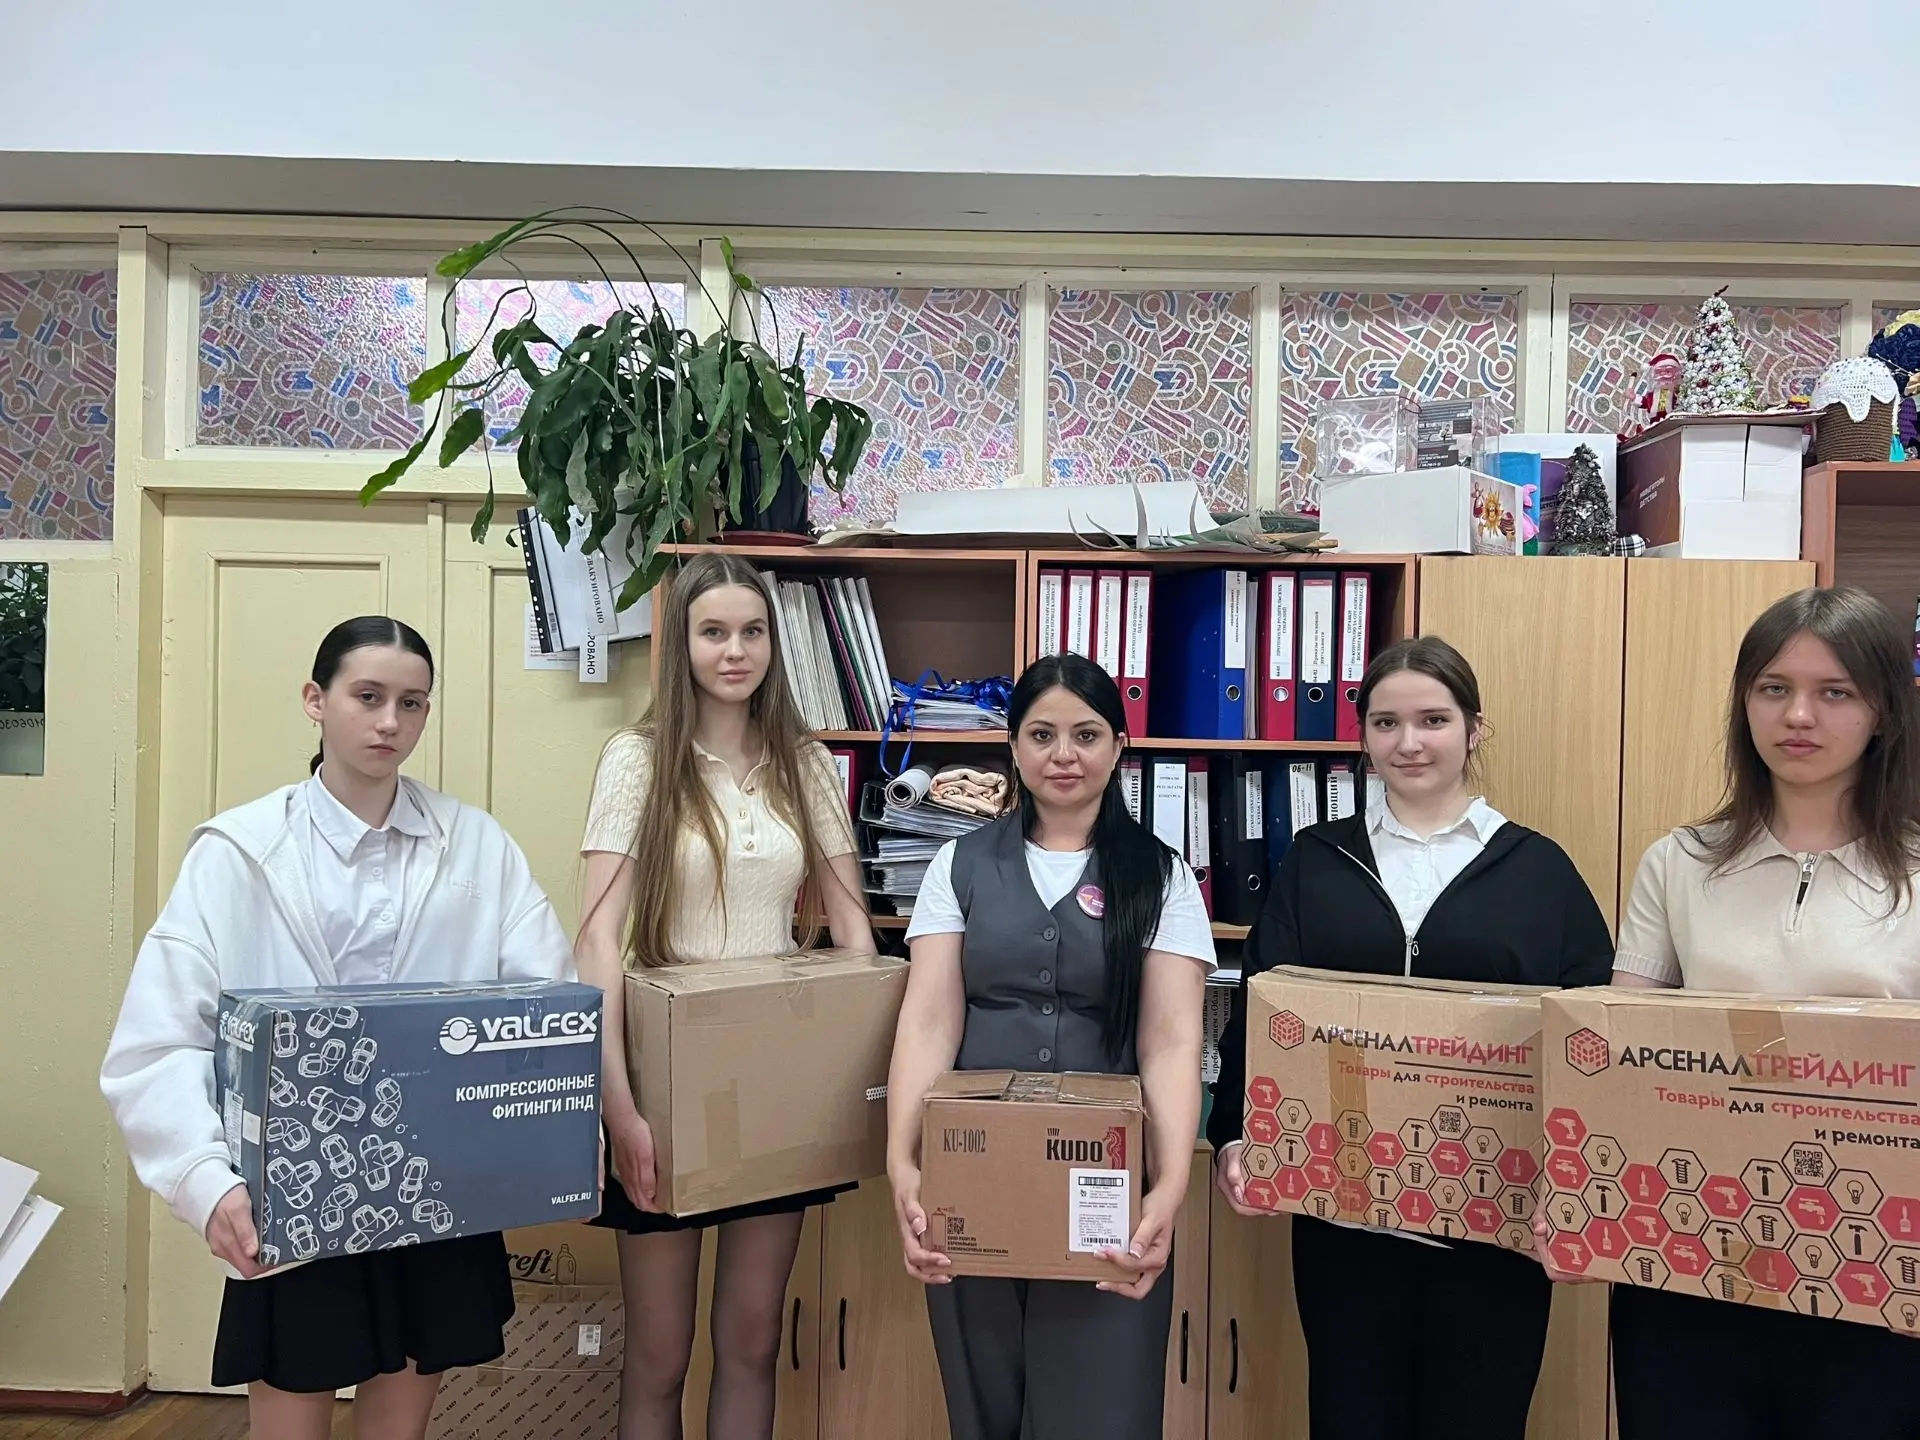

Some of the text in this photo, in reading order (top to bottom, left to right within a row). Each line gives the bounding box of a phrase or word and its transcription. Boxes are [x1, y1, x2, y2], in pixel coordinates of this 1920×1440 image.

[587, 628, 596, 675] РОВАНО
[481, 1011, 598, 1042] VALFEX
[1311, 1025, 1533, 1065] АРСЕНАЛТРЕЙДИНГ
[1337, 1060, 1535, 1095] Товары для строительства
[1618, 1045, 1917, 1089] АРСЕНАЛТРЕЙДИНГ
[456, 1074, 595, 1102] КОМПРЕССИОННЫЕ
[492, 1094, 594, 1120] ФИТИНГИ ПНД
[1456, 1095, 1534, 1112] и ремонта
[1654, 1086, 1920, 1126] Товары для строительства
[944, 1128, 986, 1153] KU-1002
[1046, 1138, 1103, 1162] KUDO
[1814, 1128, 1920, 1150] и ремонта
[551, 1192, 592, 1206] VALFEX.RU
